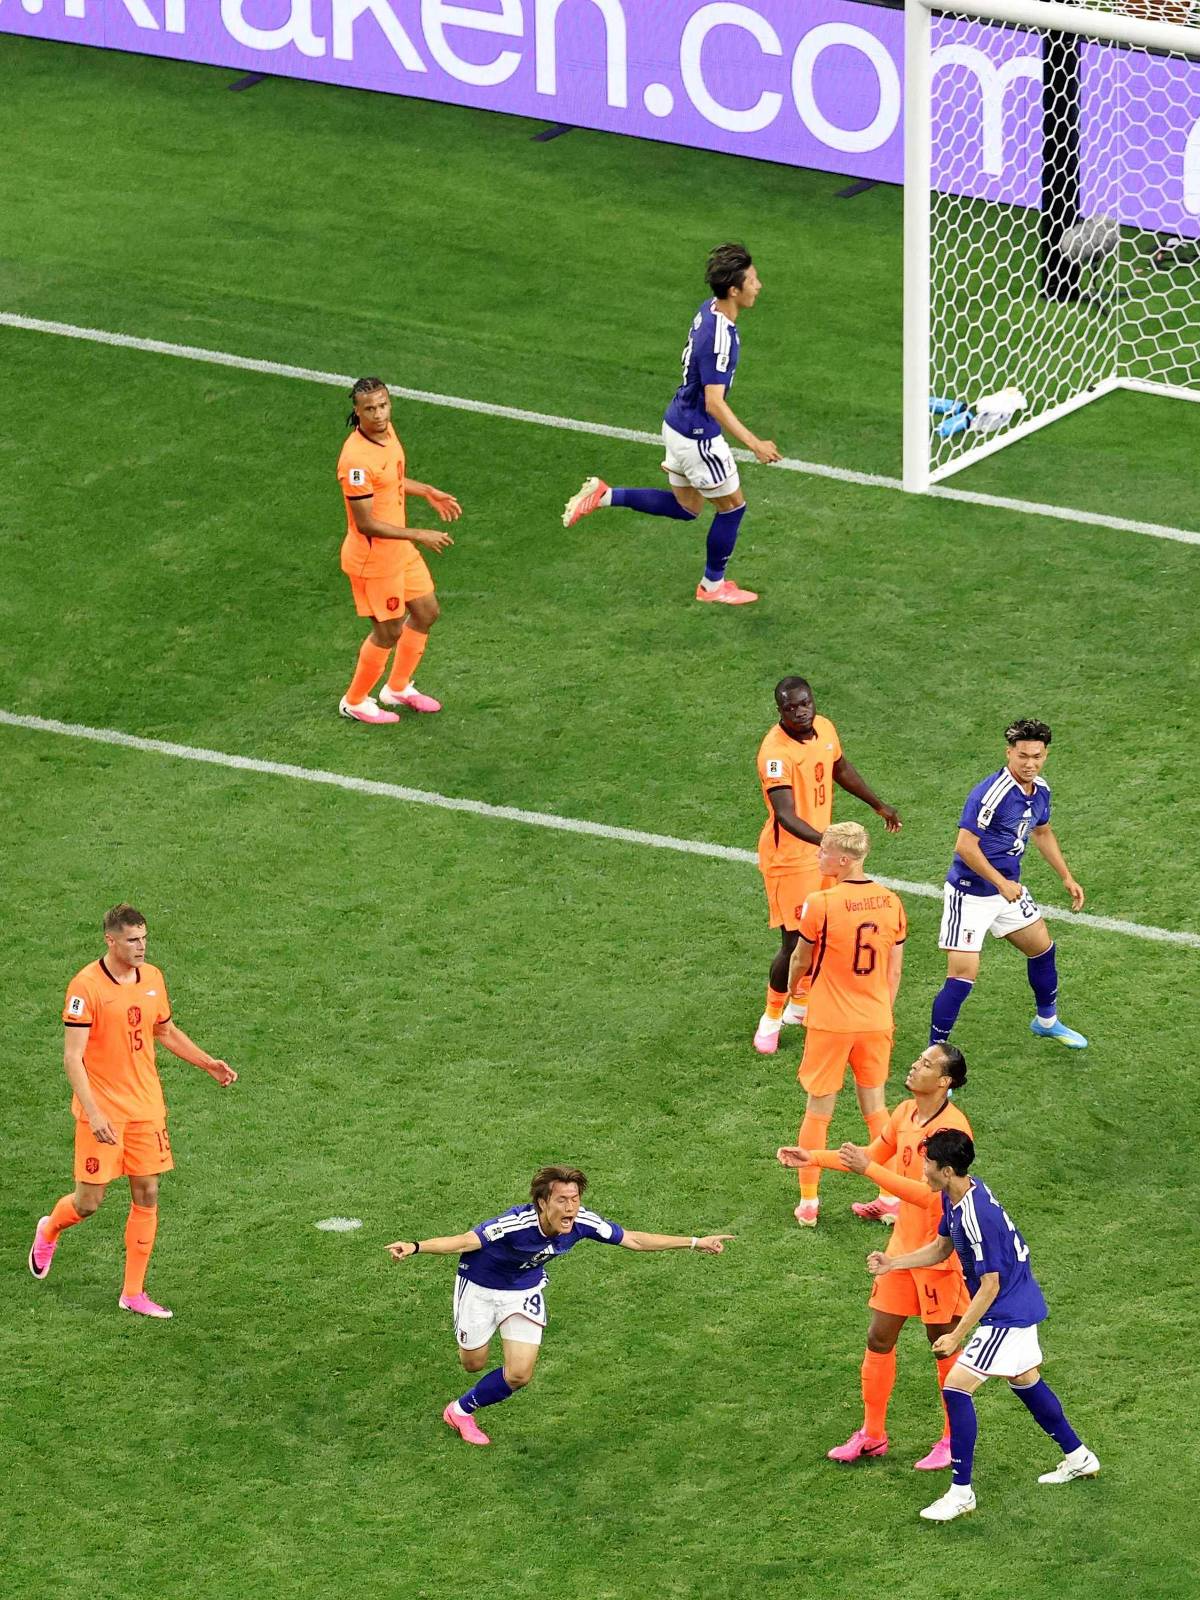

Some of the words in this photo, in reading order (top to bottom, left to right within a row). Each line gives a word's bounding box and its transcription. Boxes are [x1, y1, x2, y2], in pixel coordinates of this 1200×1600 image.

[65, 0, 1043, 175] ken.com
[813, 784, 825, 808] 19
[853, 921, 878, 975] 6
[128, 1029, 142, 1053] 15
[924, 1284, 938, 1305] 4
